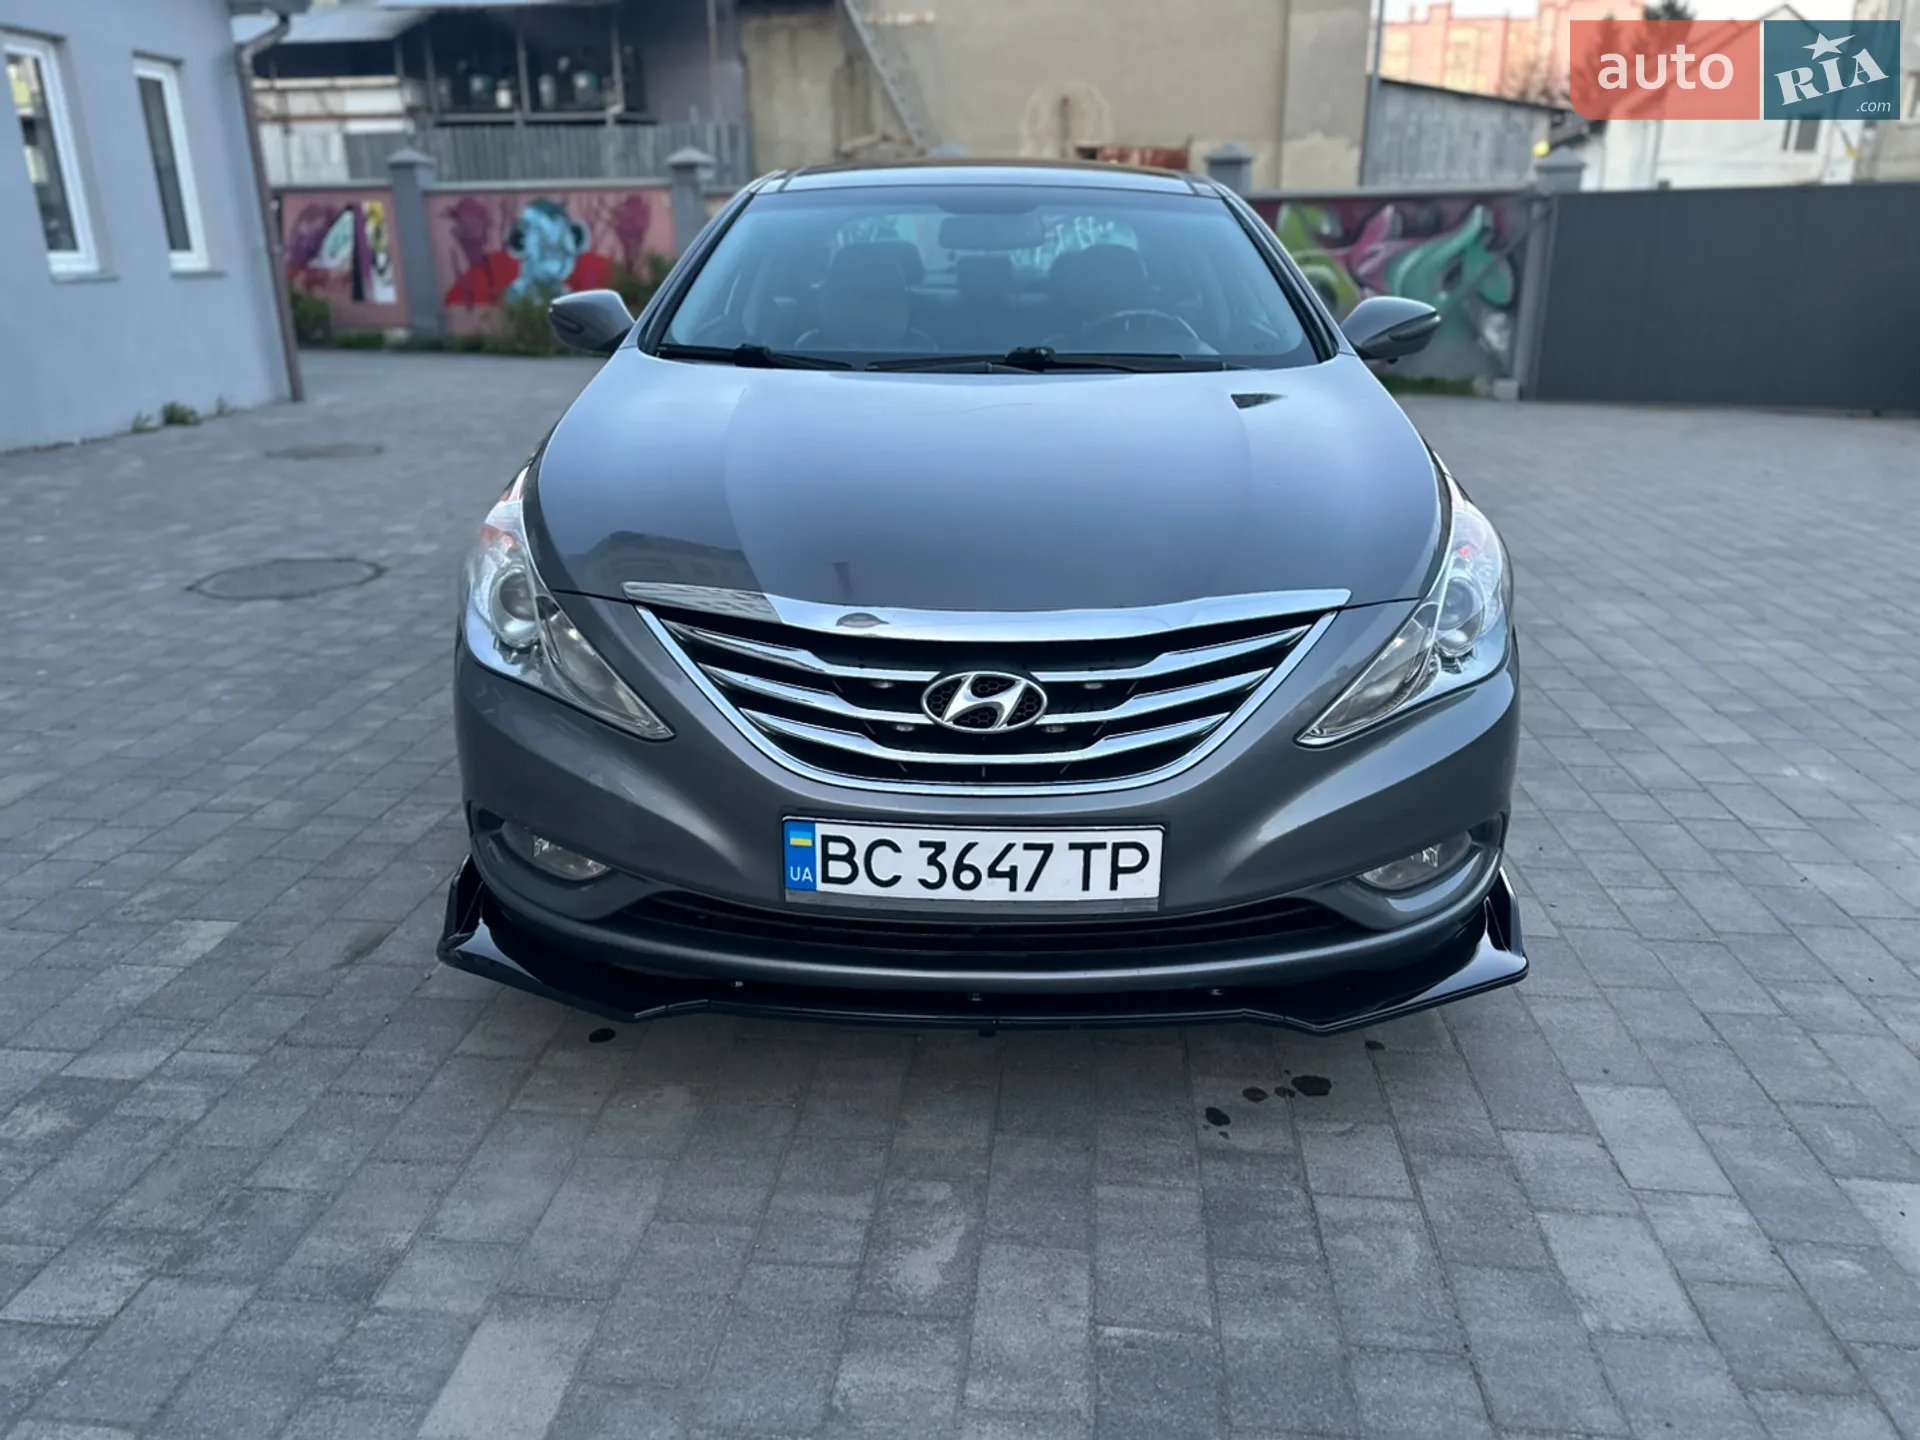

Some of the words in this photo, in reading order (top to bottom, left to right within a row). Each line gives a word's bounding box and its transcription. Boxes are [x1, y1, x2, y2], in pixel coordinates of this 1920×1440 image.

[789, 866, 813, 882] UA
[820, 834, 902, 888] BC
[917, 840, 1054, 892] 3647
[1068, 841, 1150, 891] TP
